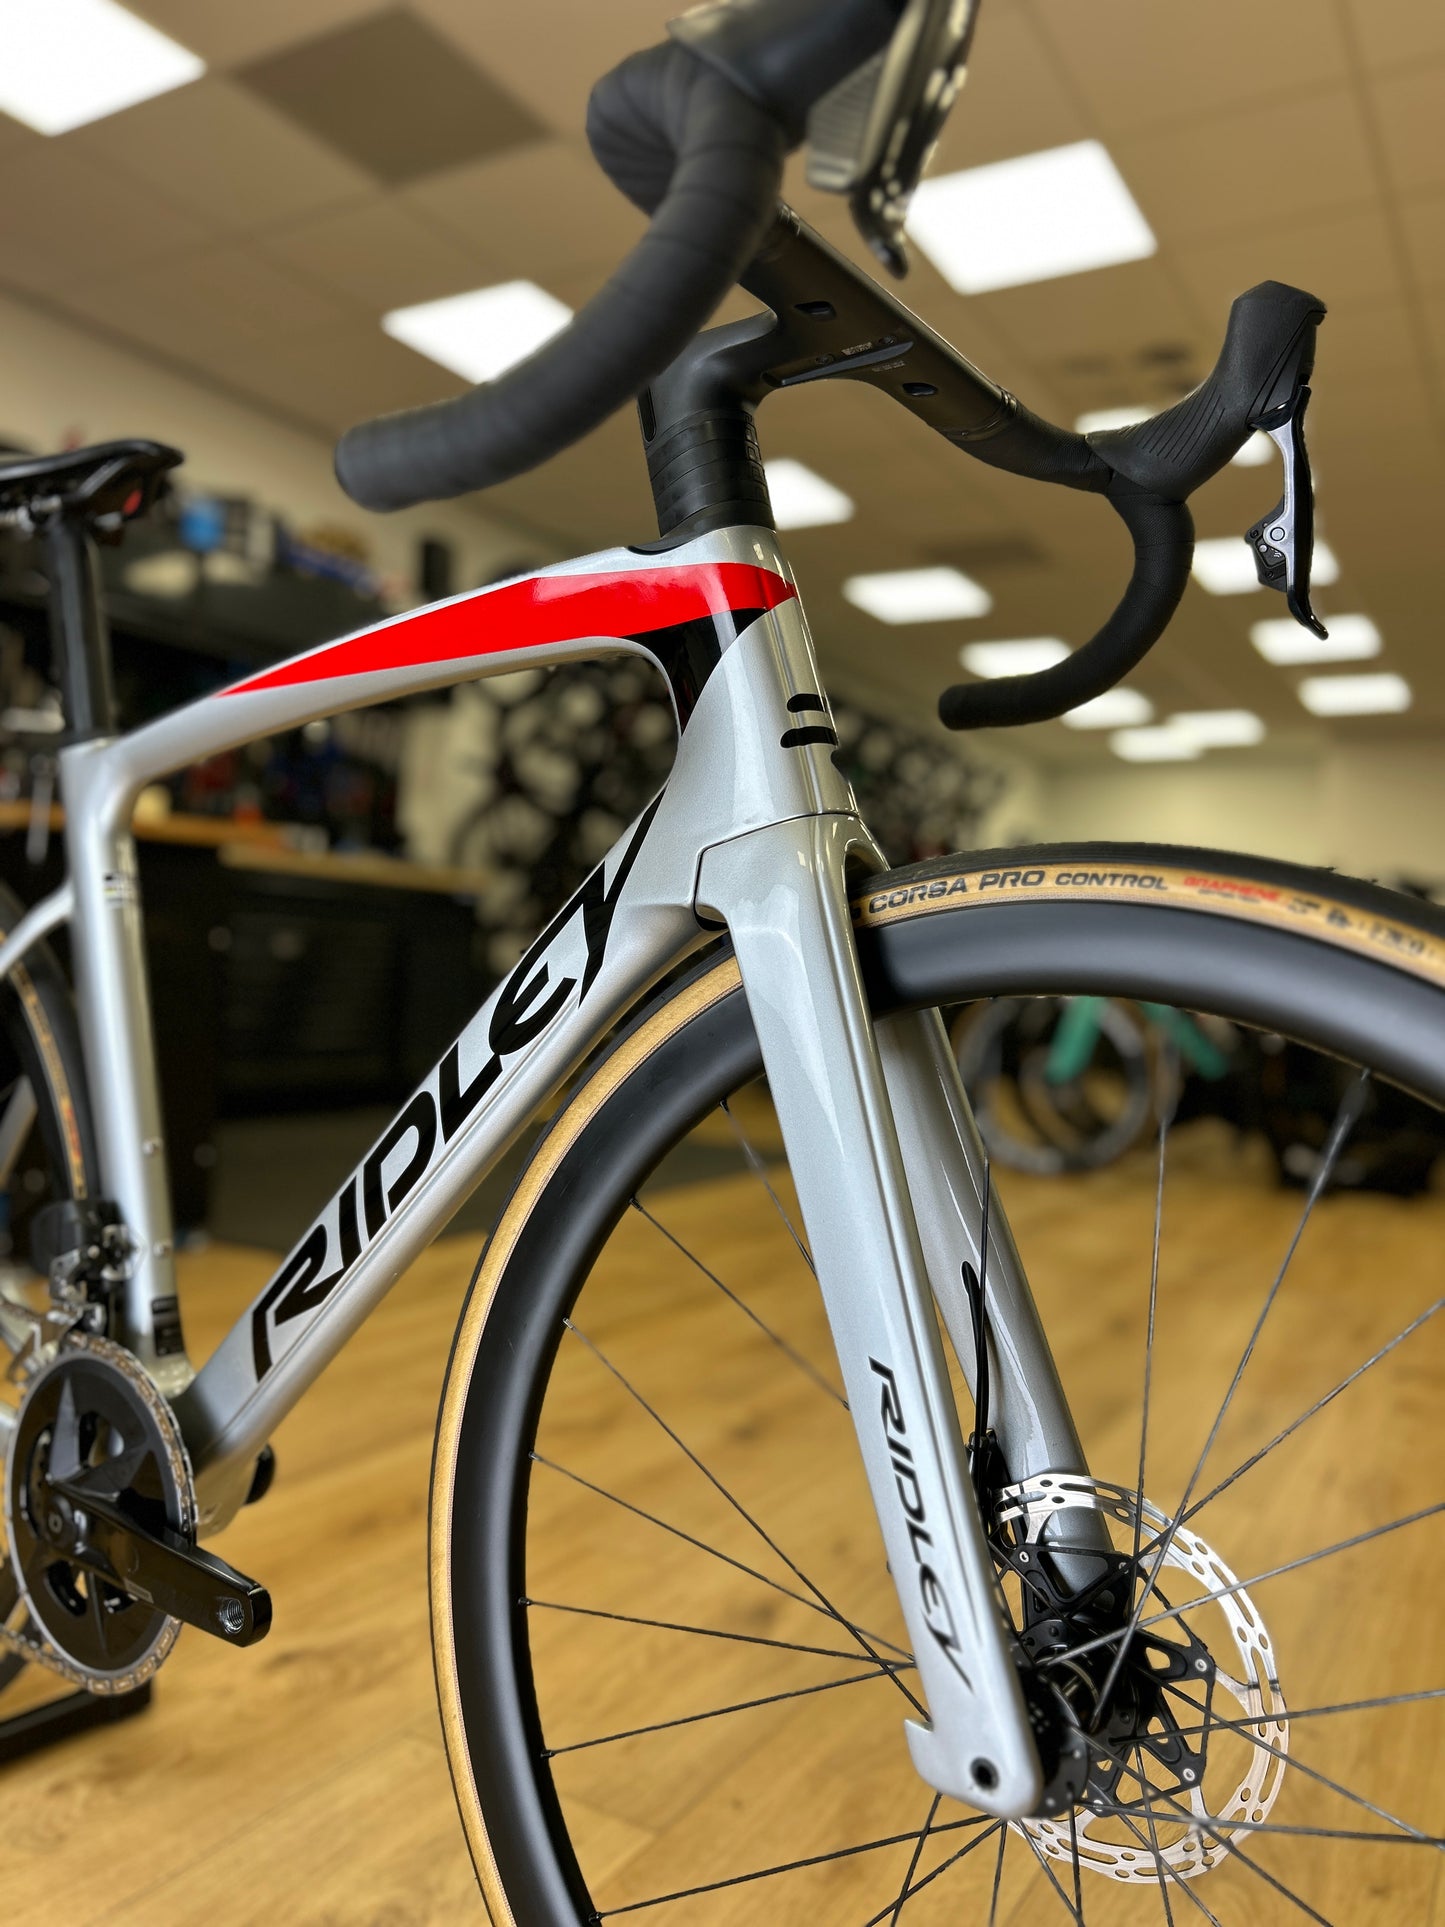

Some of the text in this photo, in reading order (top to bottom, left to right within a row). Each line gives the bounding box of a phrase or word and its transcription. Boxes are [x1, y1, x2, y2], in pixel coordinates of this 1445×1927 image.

[868, 877, 969, 914] CORSA
[978, 869, 1046, 891] PRO
[1054, 872, 1169, 891] CONTROL
[251, 784, 669, 1383] RIDLEY
[867, 1355, 976, 1695] RIDLEY
